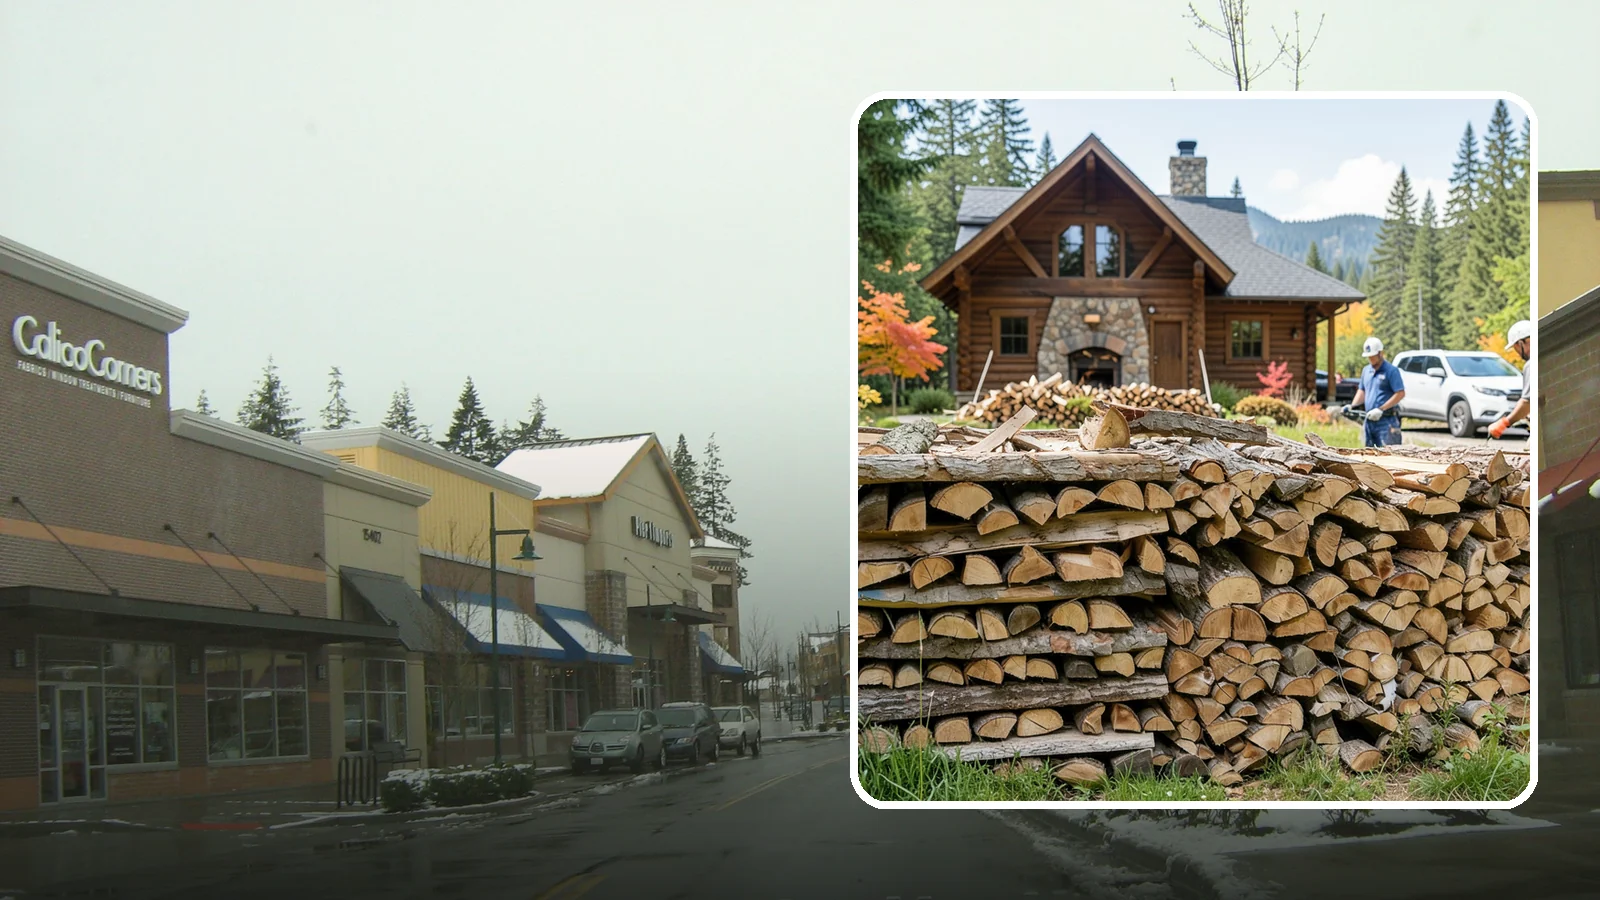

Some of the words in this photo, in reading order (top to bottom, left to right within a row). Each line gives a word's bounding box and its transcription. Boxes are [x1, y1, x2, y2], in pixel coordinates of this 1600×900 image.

[16, 360, 47, 377] FABRICS
[51, 370, 78, 386] WINDOW
[78, 379, 117, 398] TREATMENTS
